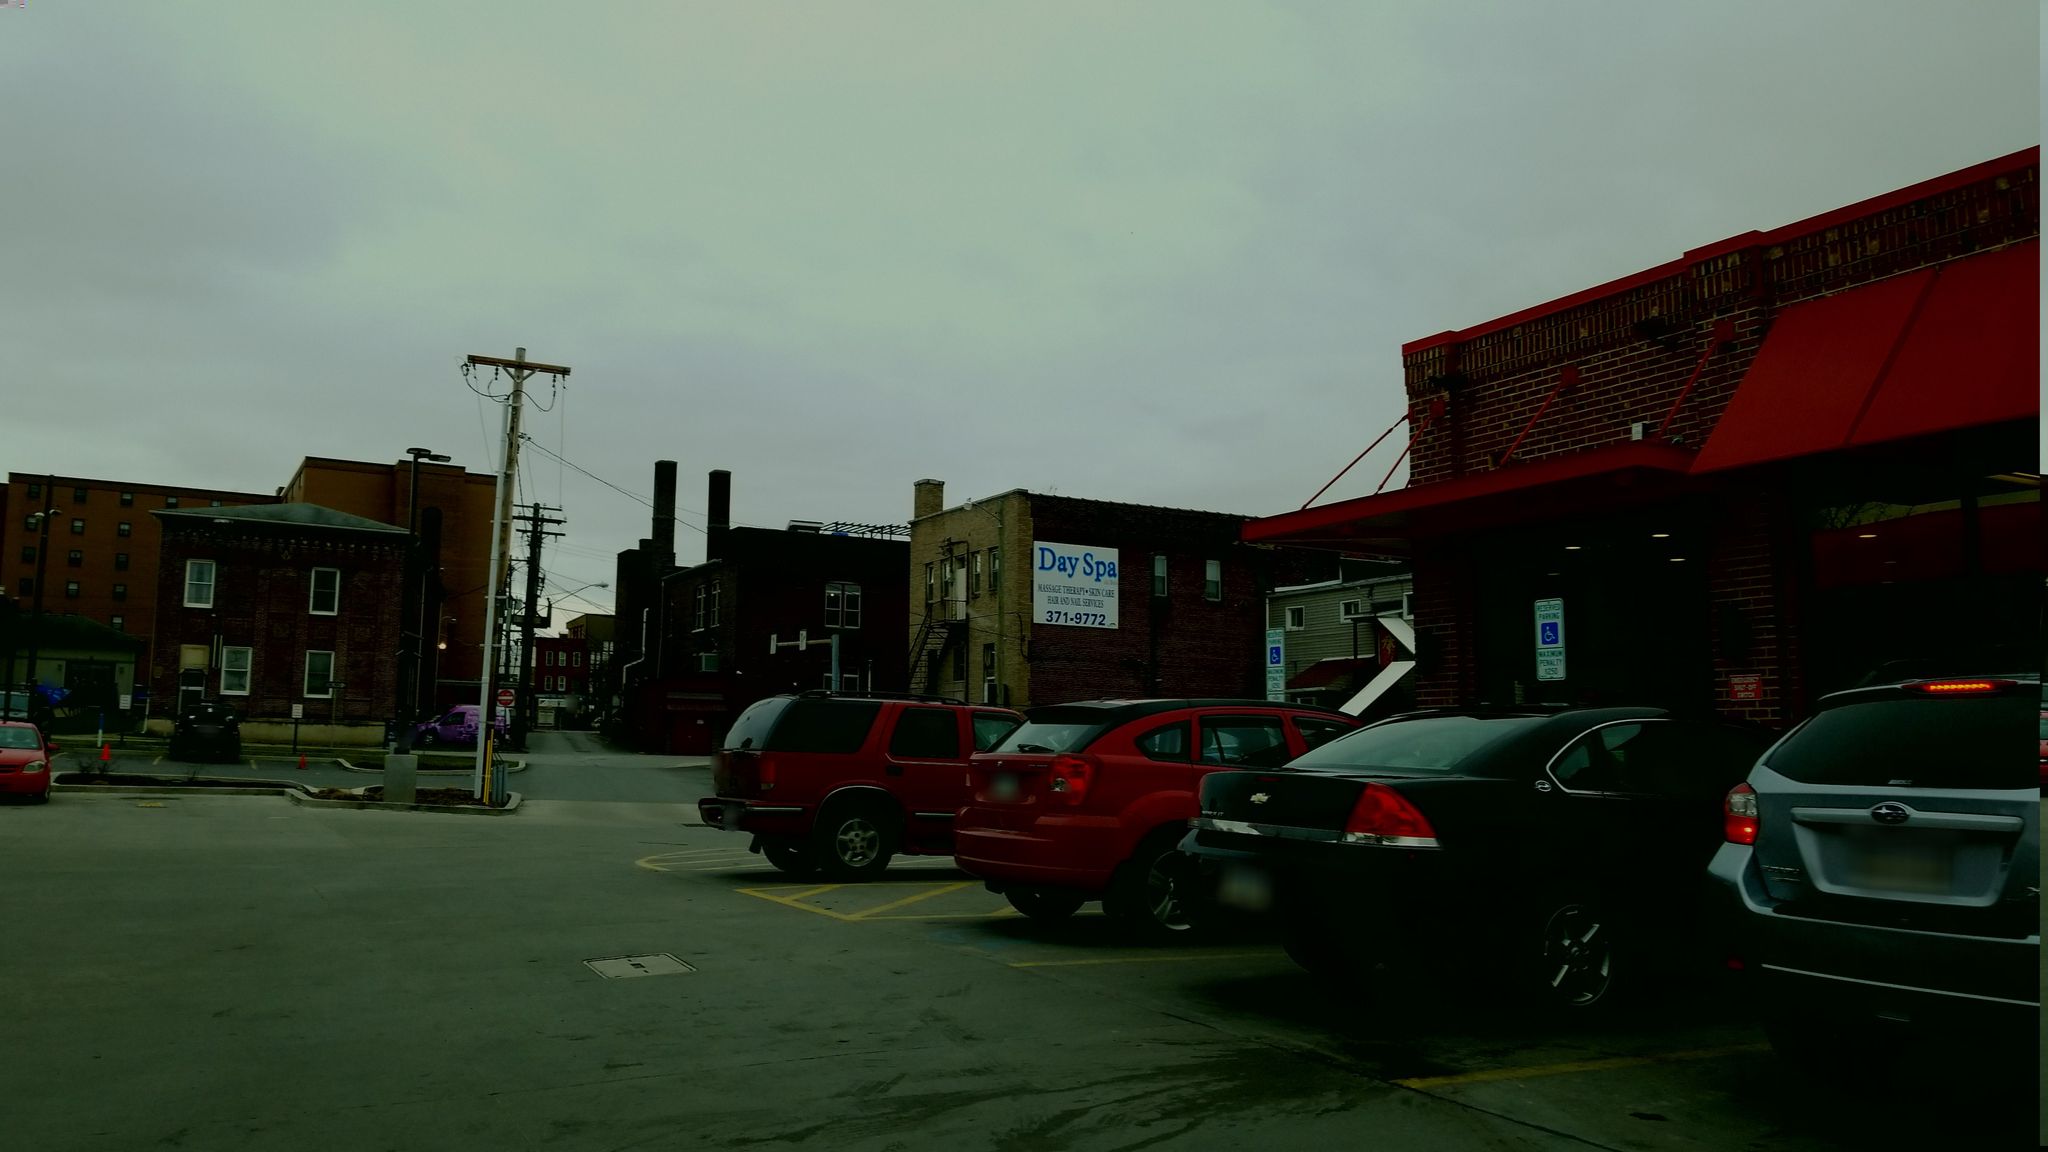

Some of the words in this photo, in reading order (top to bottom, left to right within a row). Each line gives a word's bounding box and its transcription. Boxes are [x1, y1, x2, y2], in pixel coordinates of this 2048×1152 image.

[1039, 547, 1079, 578] Day
[1083, 553, 1117, 581] Spa
[1038, 583, 1062, 594] MASSAGE
[1062, 586, 1085, 596] THERAPY
[1088, 588, 1101, 597] SKIN
[1101, 588, 1115, 598] CARE
[1047, 595, 1059, 605] HAIR
[1060, 597, 1070, 606] AND
[1070, 597, 1082, 607] NAIL
[1082, 598, 1105, 609] SERVICES
[1046, 610, 1106, 626] 371-9772
